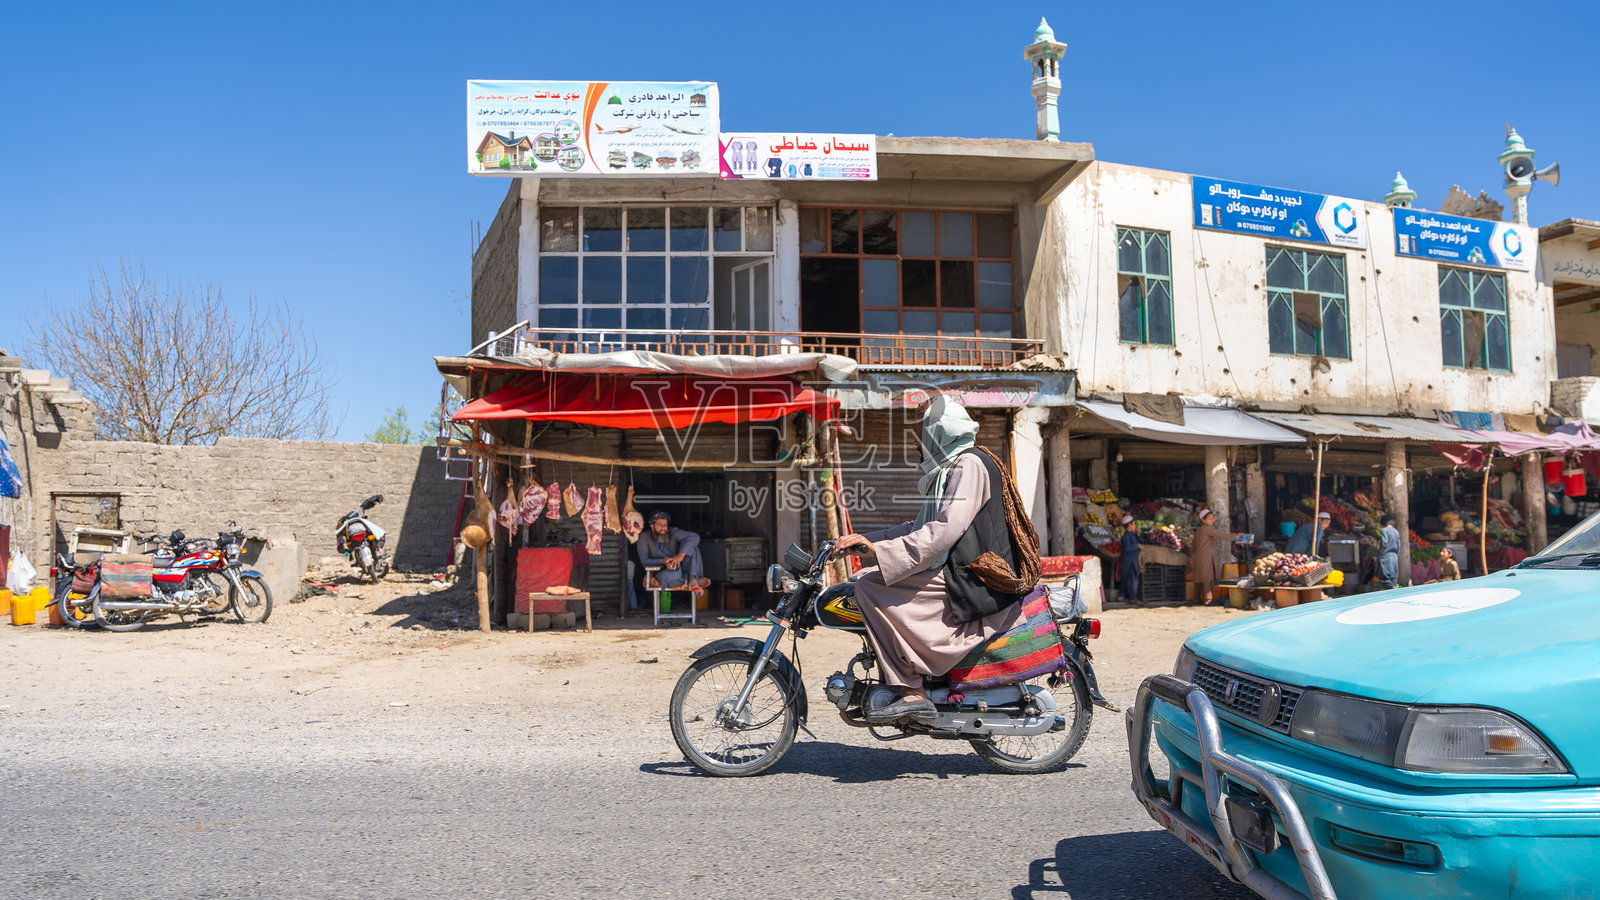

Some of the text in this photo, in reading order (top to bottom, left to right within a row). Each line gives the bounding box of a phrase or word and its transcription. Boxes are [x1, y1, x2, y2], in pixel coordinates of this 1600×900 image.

[534, 90, 561, 99] عدالت
[656, 93, 684, 103] الزاهد
[663, 110, 670, 119] او
[823, 136, 869, 154] سبحان
[1226, 201, 1250, 215] دوکان
[1278, 208, 1287, 220] او
[1460, 234, 1468, 245] او
